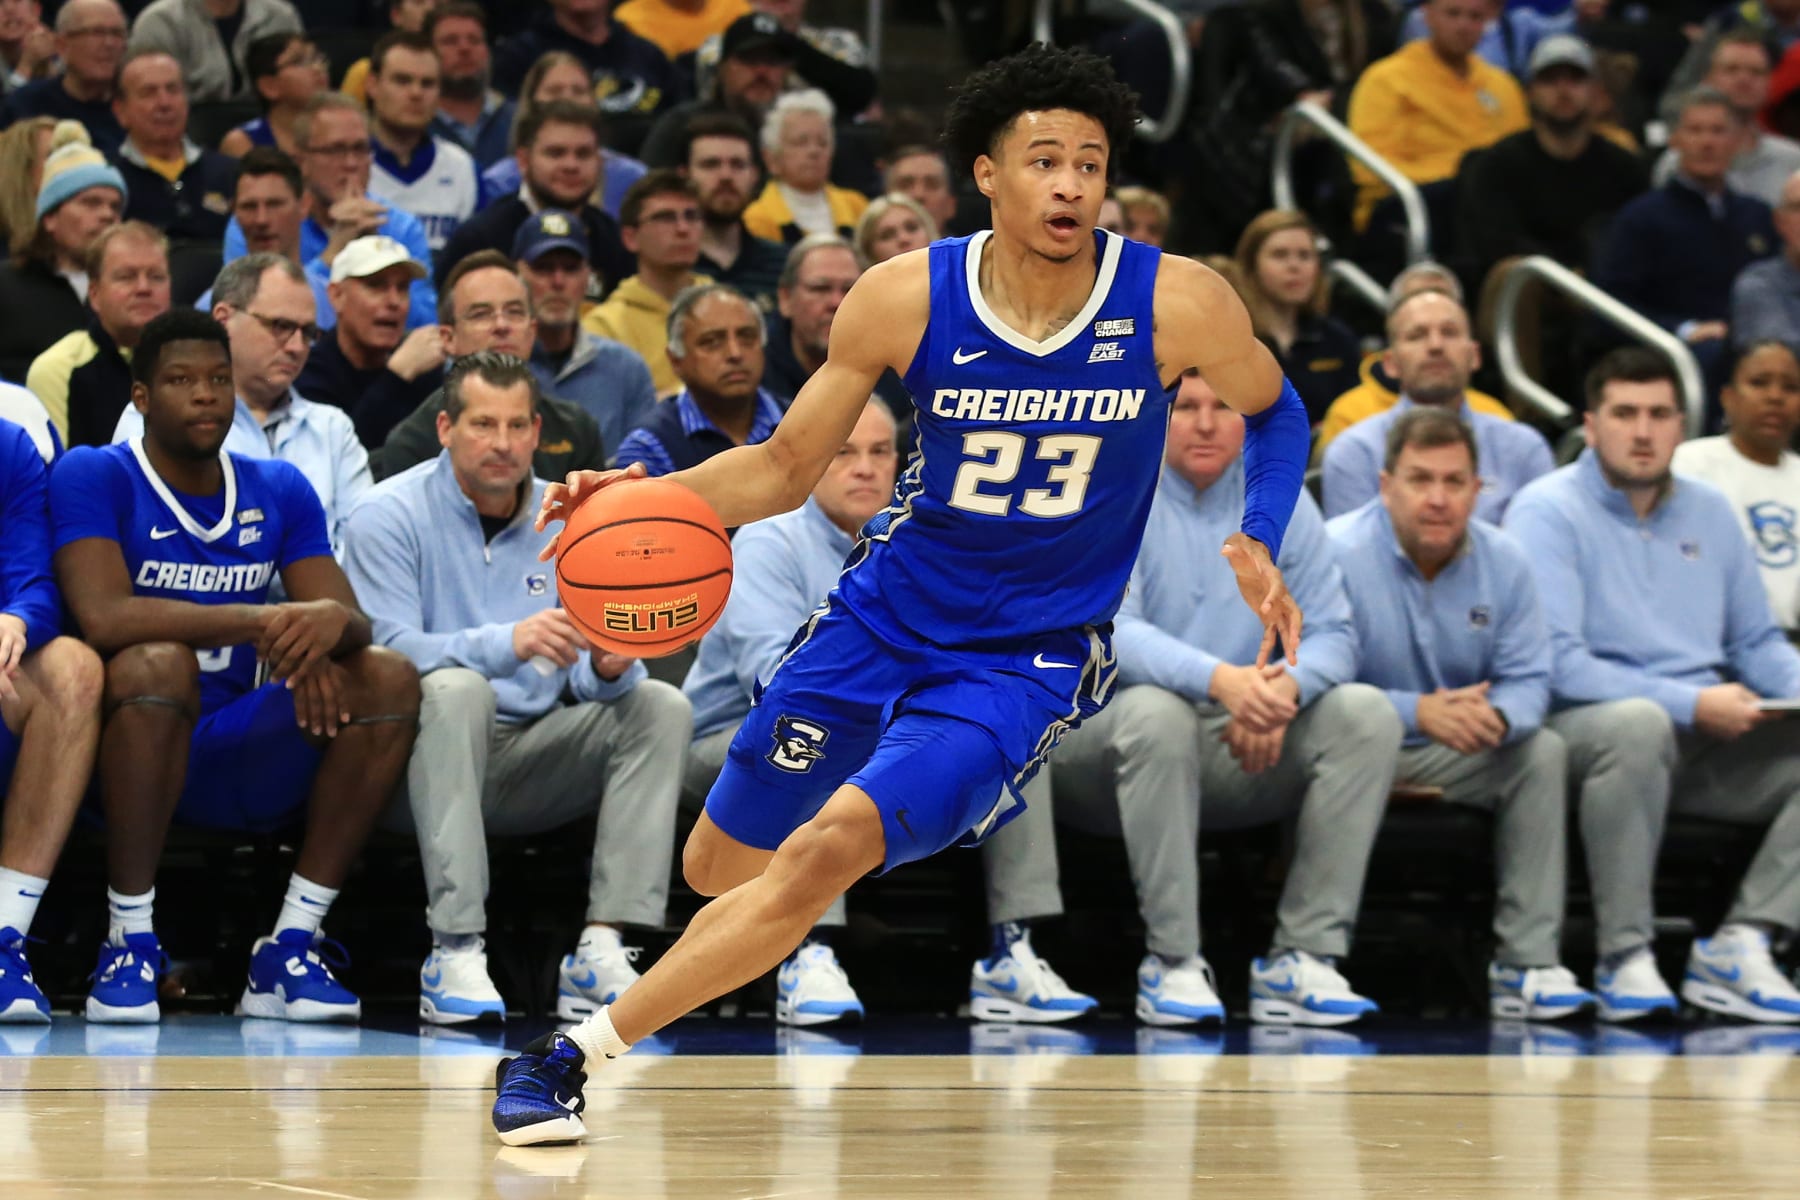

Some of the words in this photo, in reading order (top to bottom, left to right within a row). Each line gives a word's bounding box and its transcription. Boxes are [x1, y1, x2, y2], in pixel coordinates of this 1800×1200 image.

[1095, 328, 1135, 337] CHANGE
[1088, 349, 1126, 360] EAST
[1092, 342, 1119, 352] BIG
[931, 388, 1146, 422] CREIGHTON
[947, 430, 1103, 518] 23
[135, 560, 274, 592] CREIGHTON
[603, 592, 698, 611] CHAMPIONSHIP
[604, 600, 698, 633] ELITE
